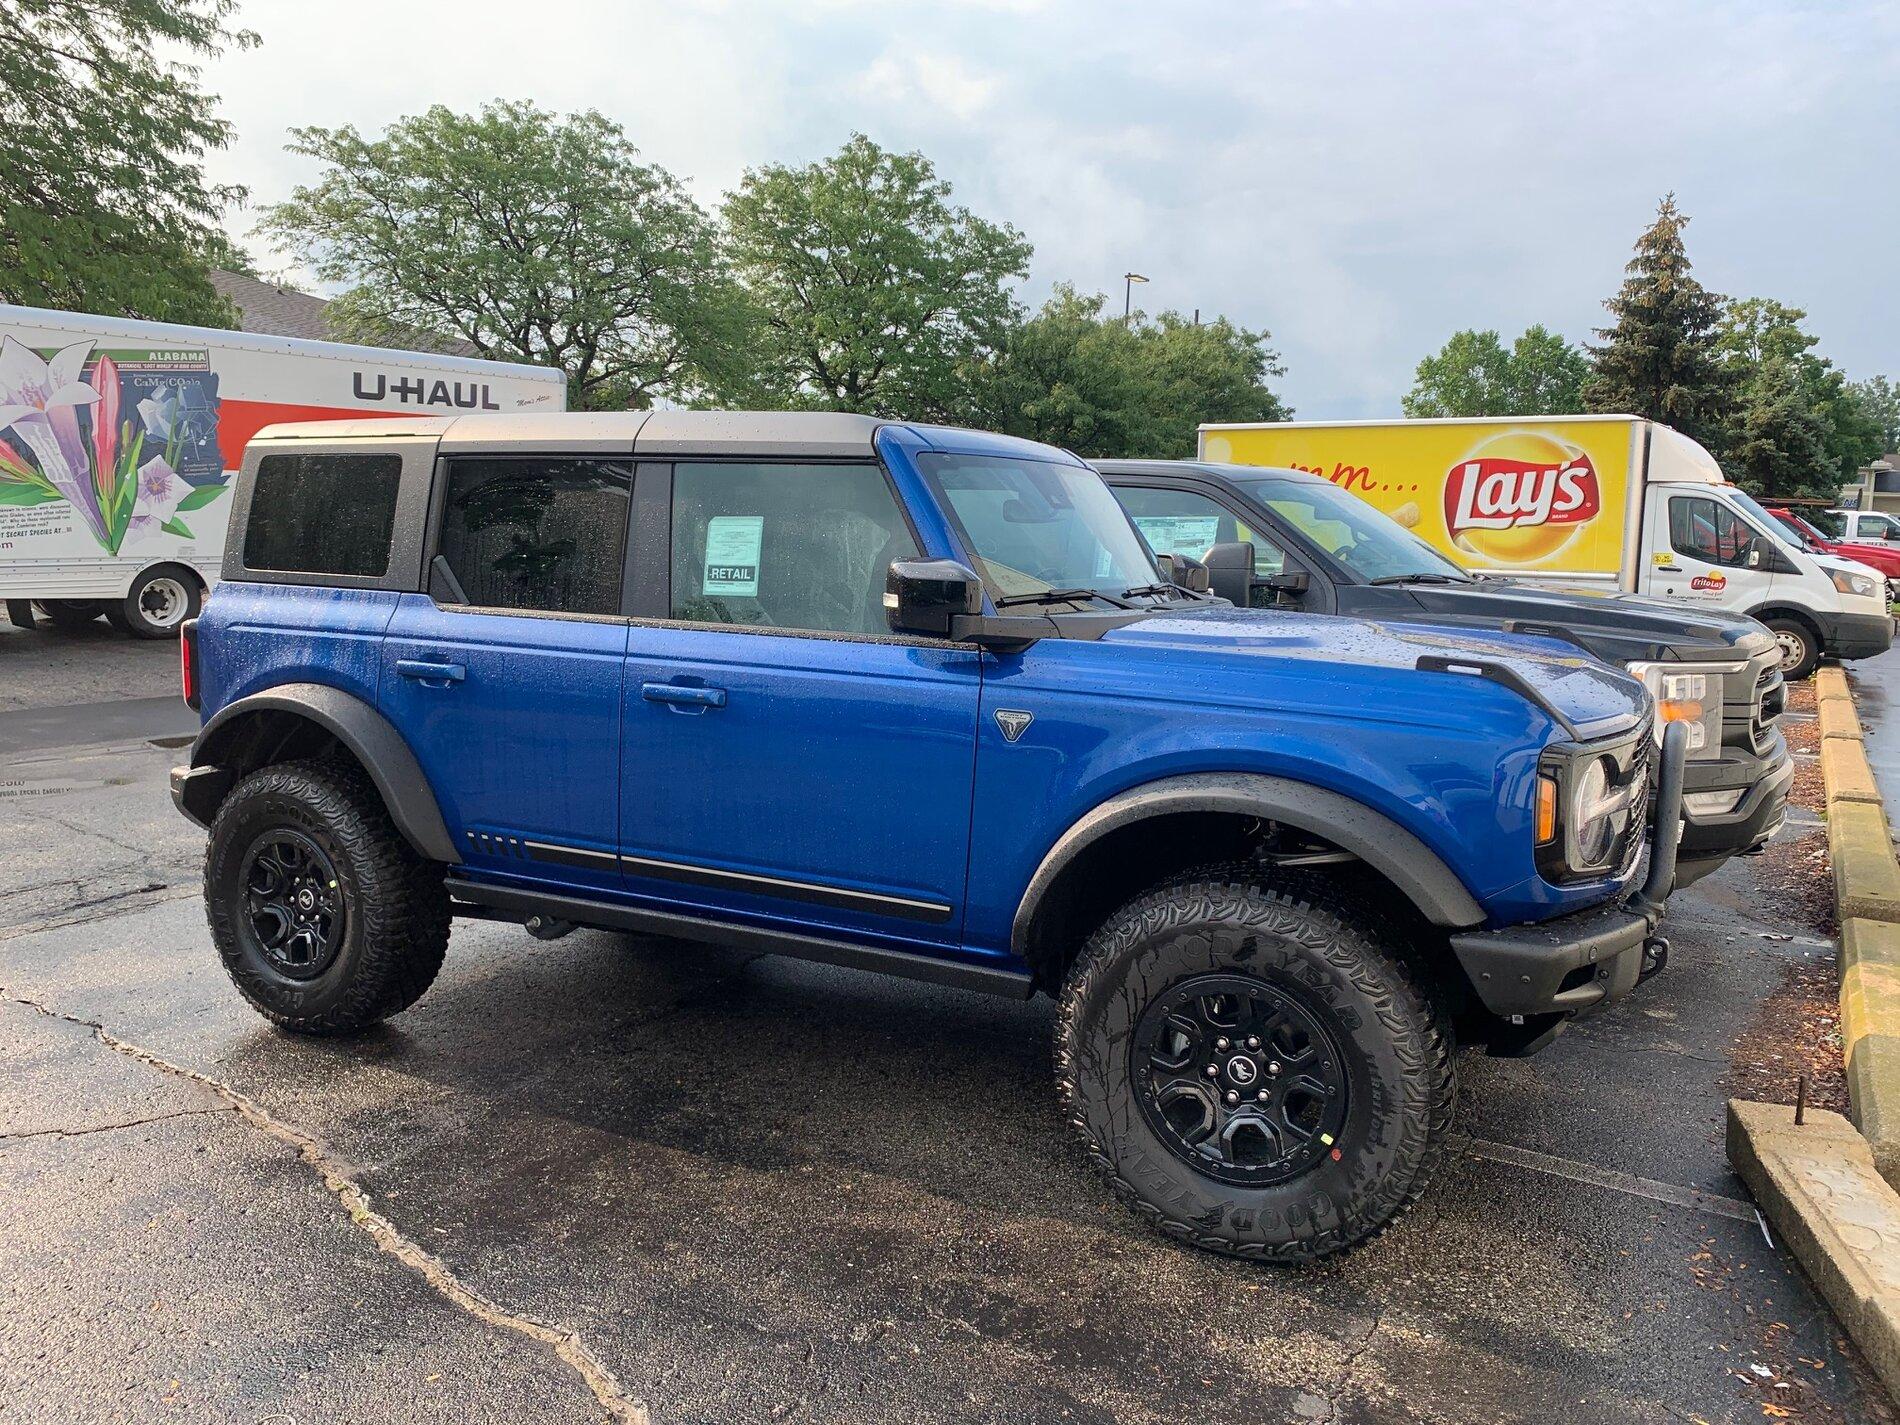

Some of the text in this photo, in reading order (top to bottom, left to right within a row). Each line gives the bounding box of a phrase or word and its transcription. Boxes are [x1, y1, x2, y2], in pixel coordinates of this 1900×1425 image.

[149, 352, 206, 361] ALABAMA
[1453, 460, 1589, 530] Lay's
[6, 530, 28, 538] SECRET
[29, 528, 53, 536] SPECIES
[711, 567, 751, 580] RETAIL
